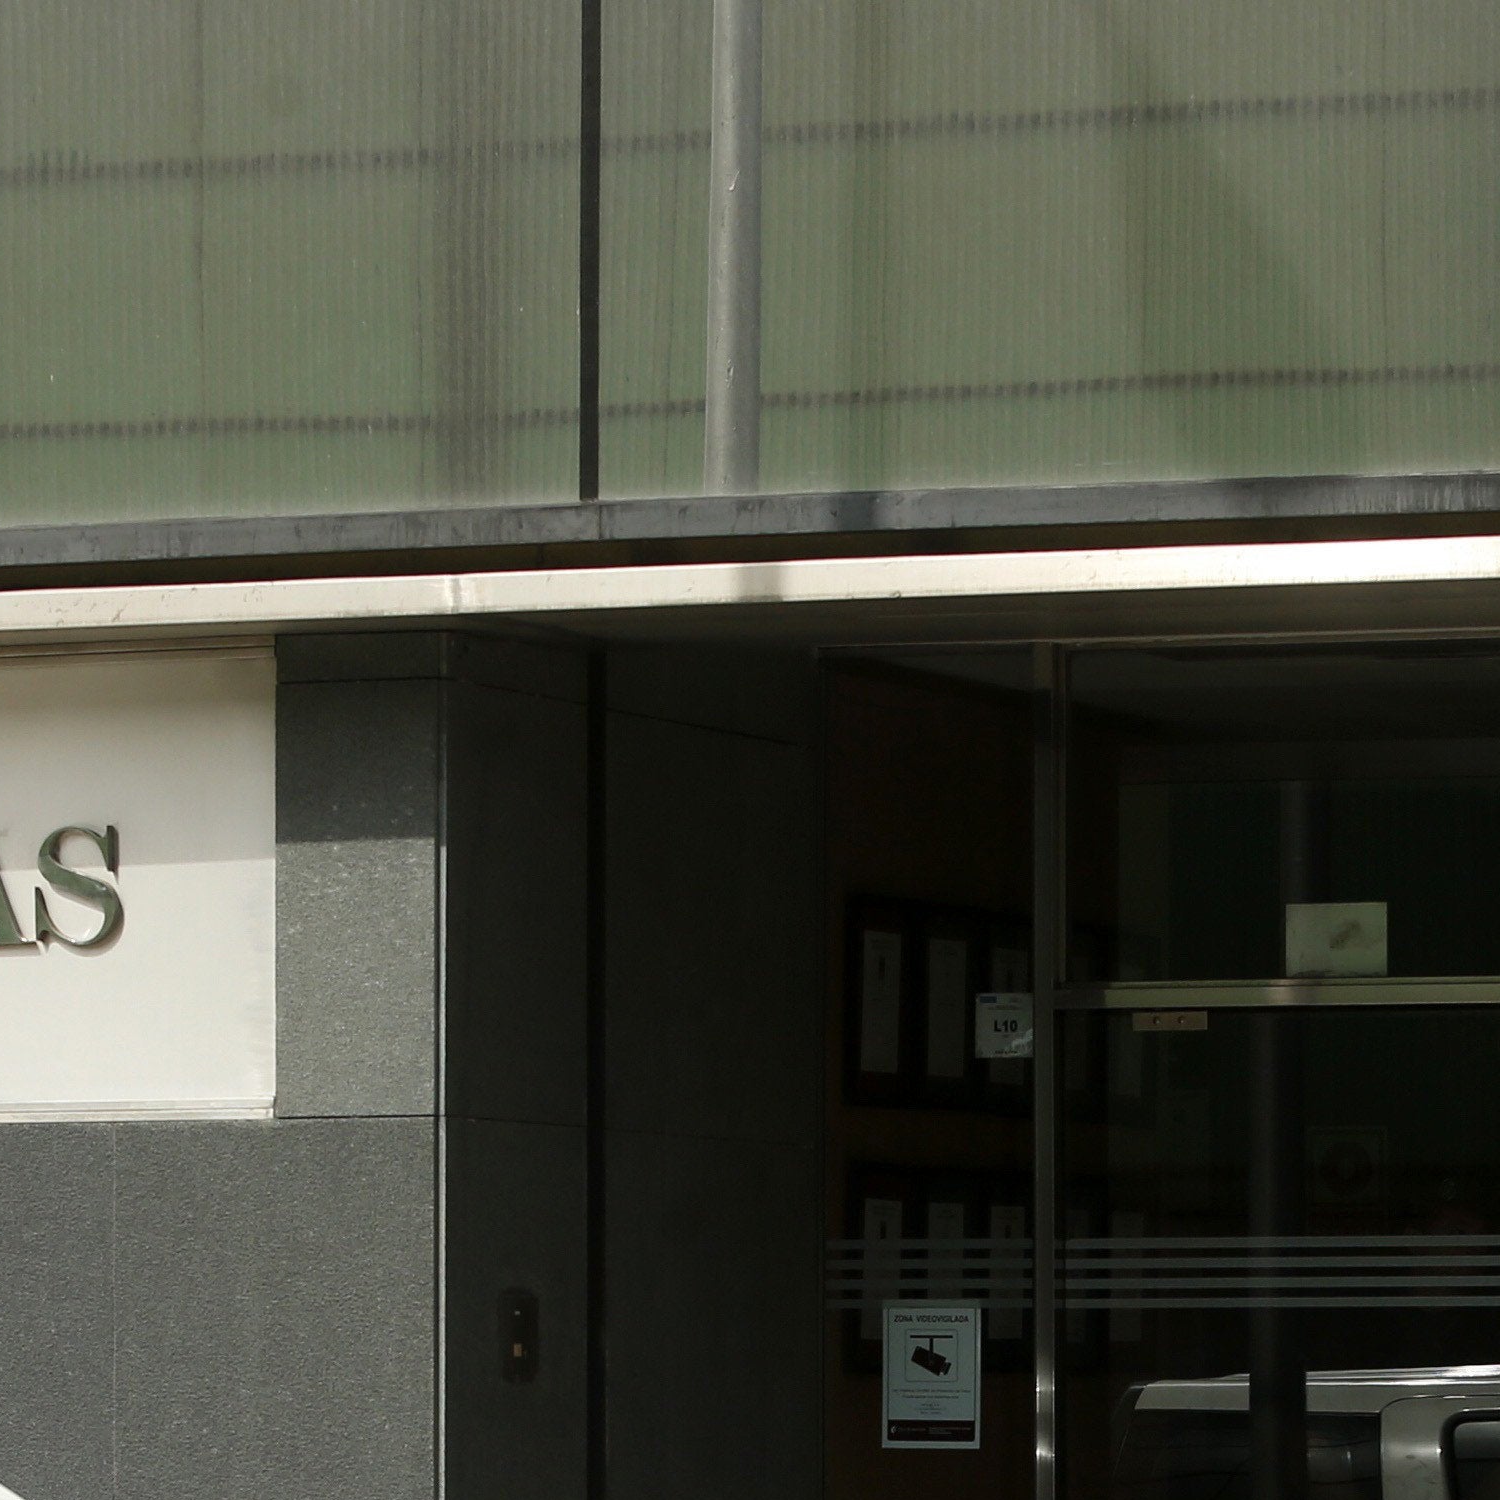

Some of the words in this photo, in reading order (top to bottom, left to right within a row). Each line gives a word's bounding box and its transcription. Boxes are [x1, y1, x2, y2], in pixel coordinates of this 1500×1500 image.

[993, 1019, 1019, 1033] L10
[894, 1314, 913, 1323] ZONA
[916, 1314, 969, 1324] VIDEOVIGILADA
